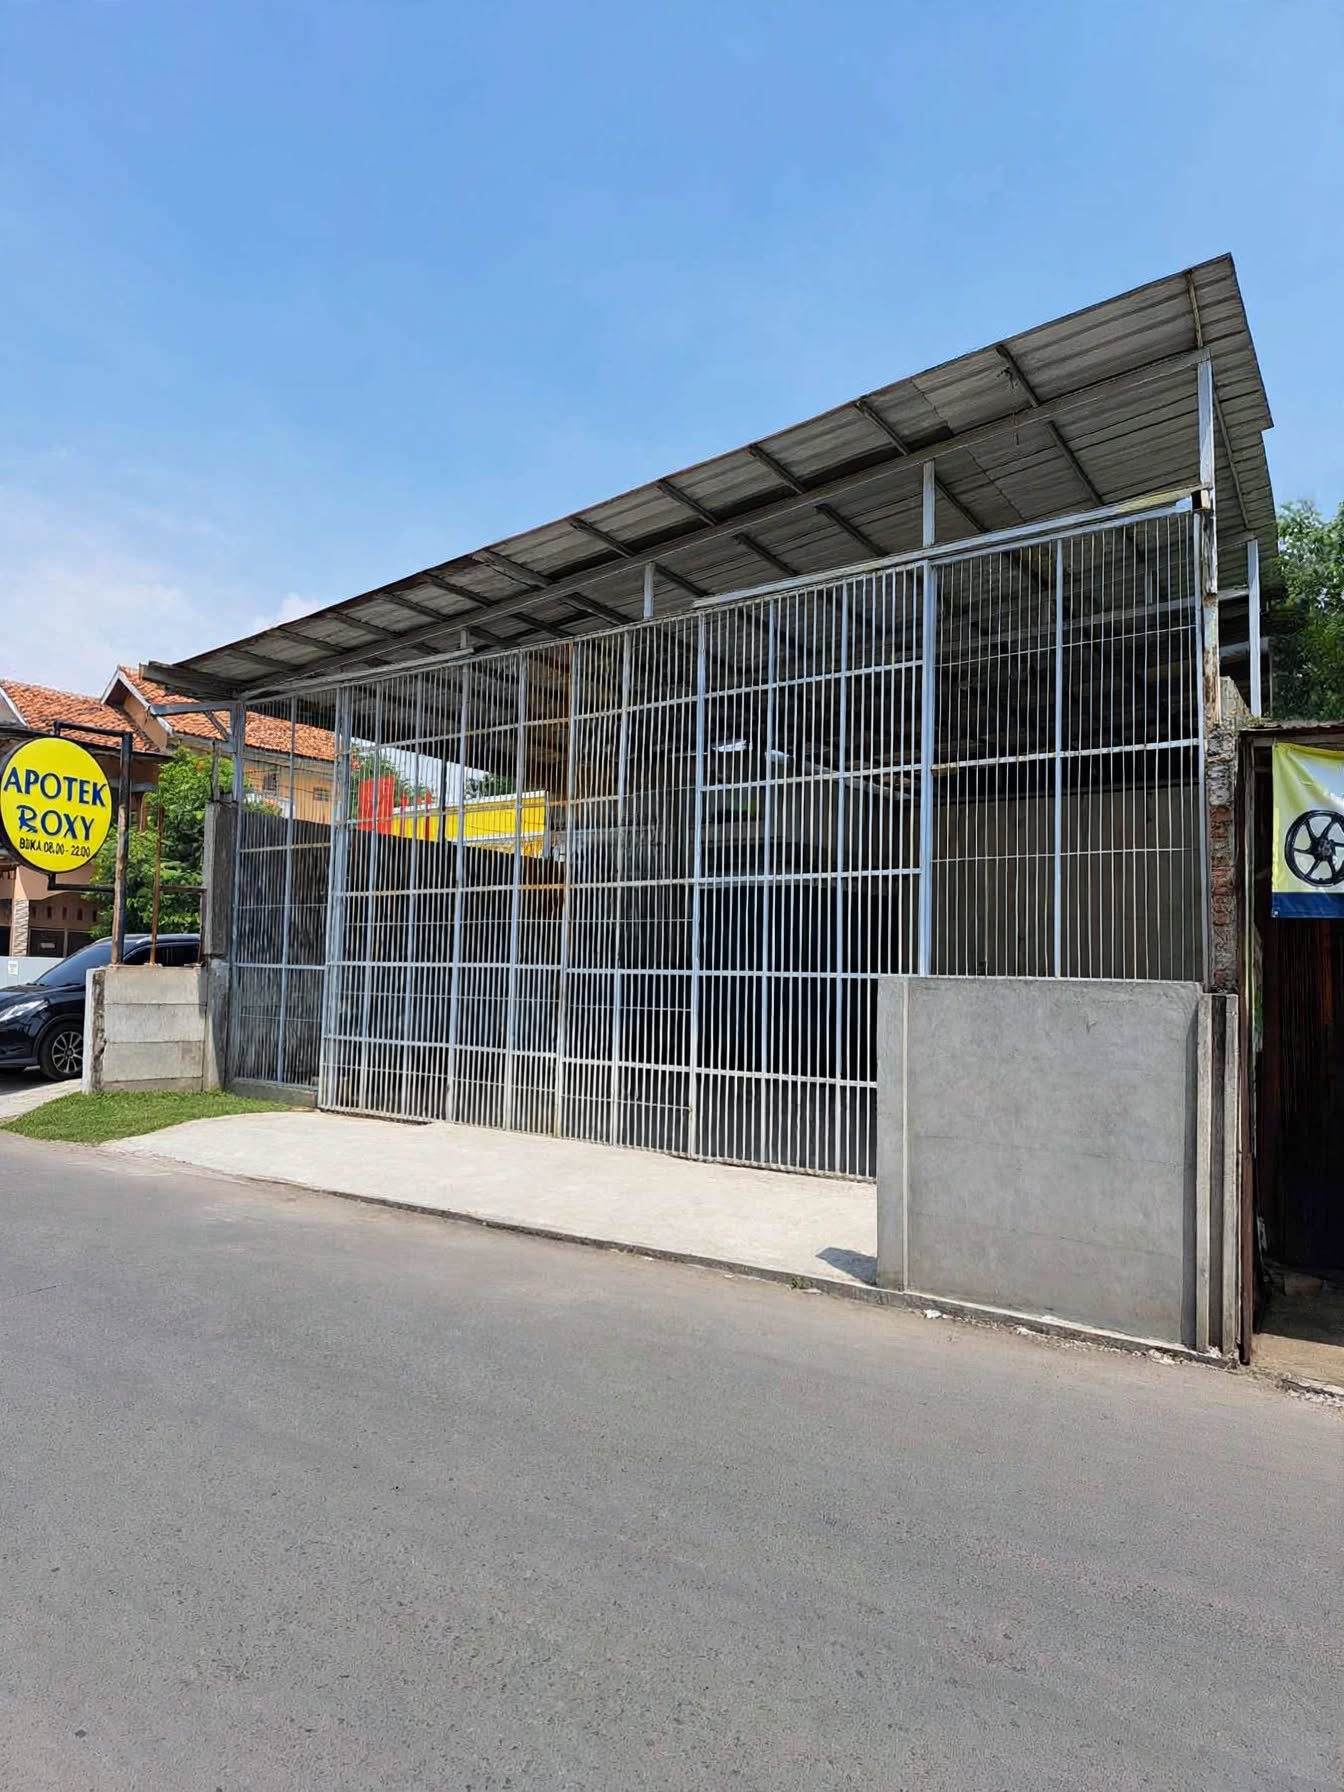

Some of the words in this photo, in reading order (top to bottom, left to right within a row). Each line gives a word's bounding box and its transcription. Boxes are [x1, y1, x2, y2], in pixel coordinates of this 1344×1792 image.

[3, 766, 107, 807] APOTEK
[16, 804, 94, 841] ROXY
[19, 837, 41, 851] BUKA
